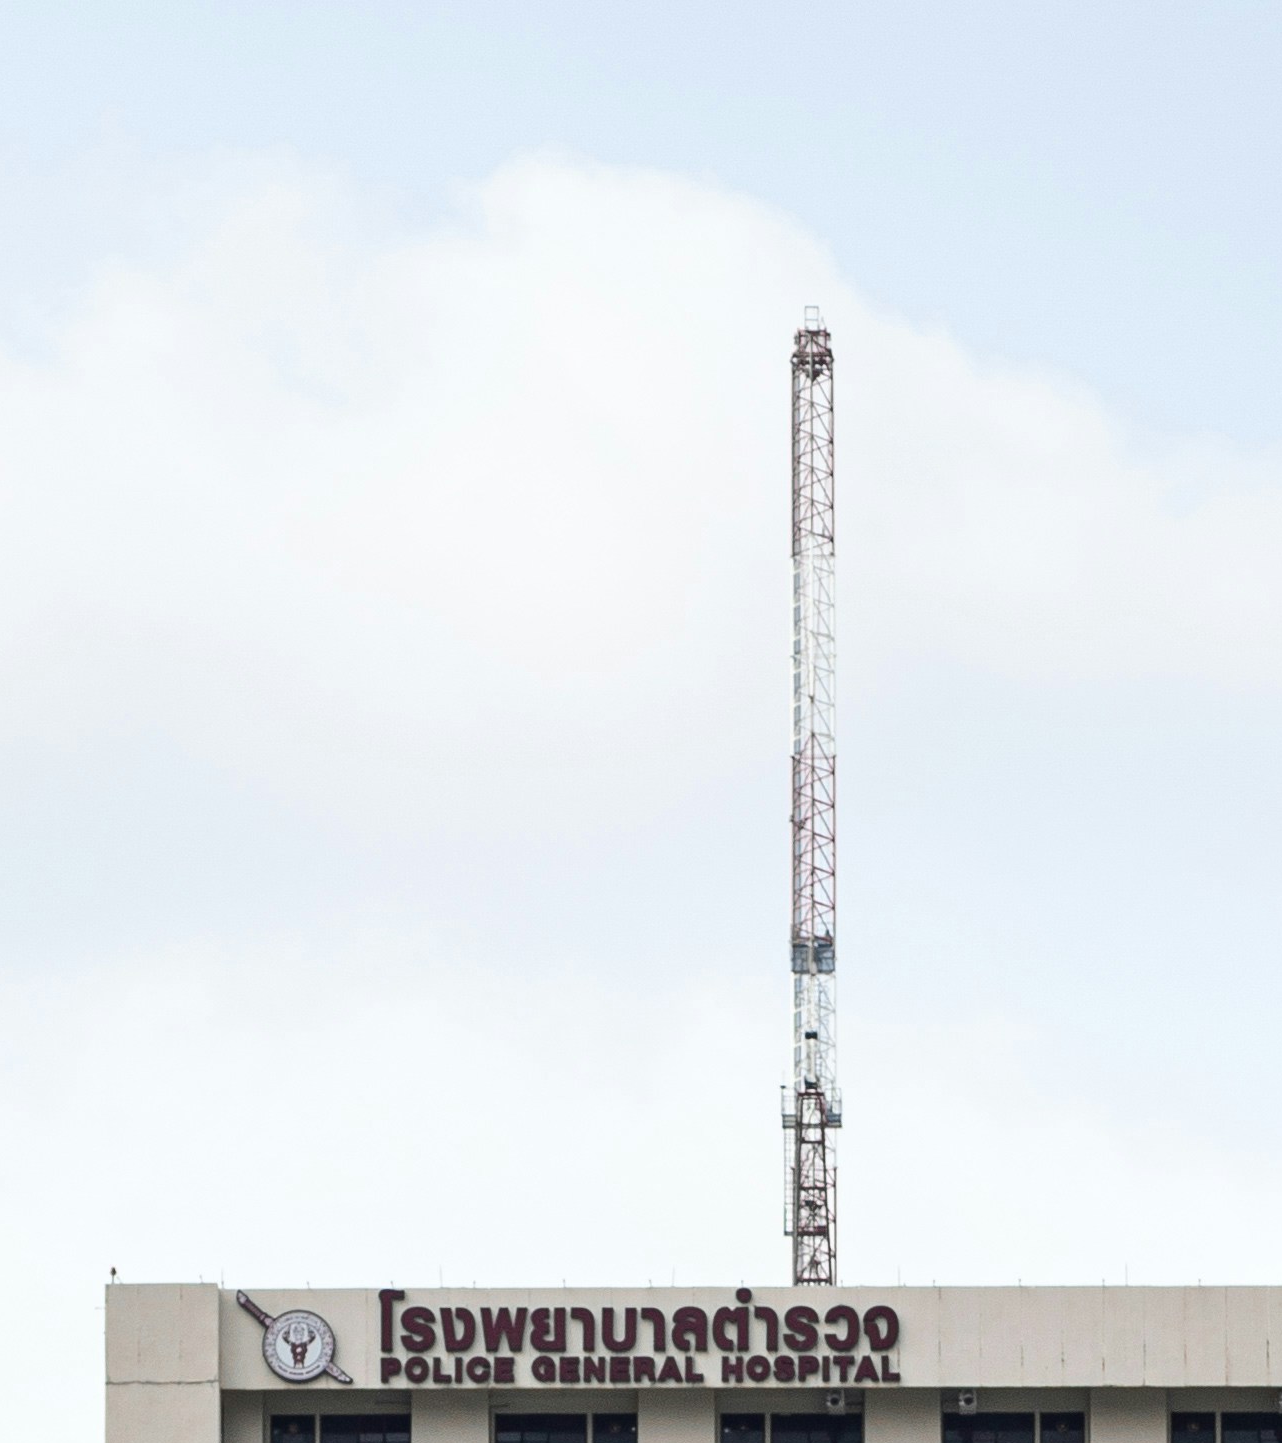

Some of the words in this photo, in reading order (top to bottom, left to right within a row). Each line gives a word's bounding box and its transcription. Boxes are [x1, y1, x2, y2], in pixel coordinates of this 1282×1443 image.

[379, 1287, 900, 1353] โรงพยาบาลตำรวจ
[381, 1356, 515, 1384] POLICE
[531, 1356, 704, 1384] GENERAL
[721, 1355, 901, 1383] HOSPITAL
